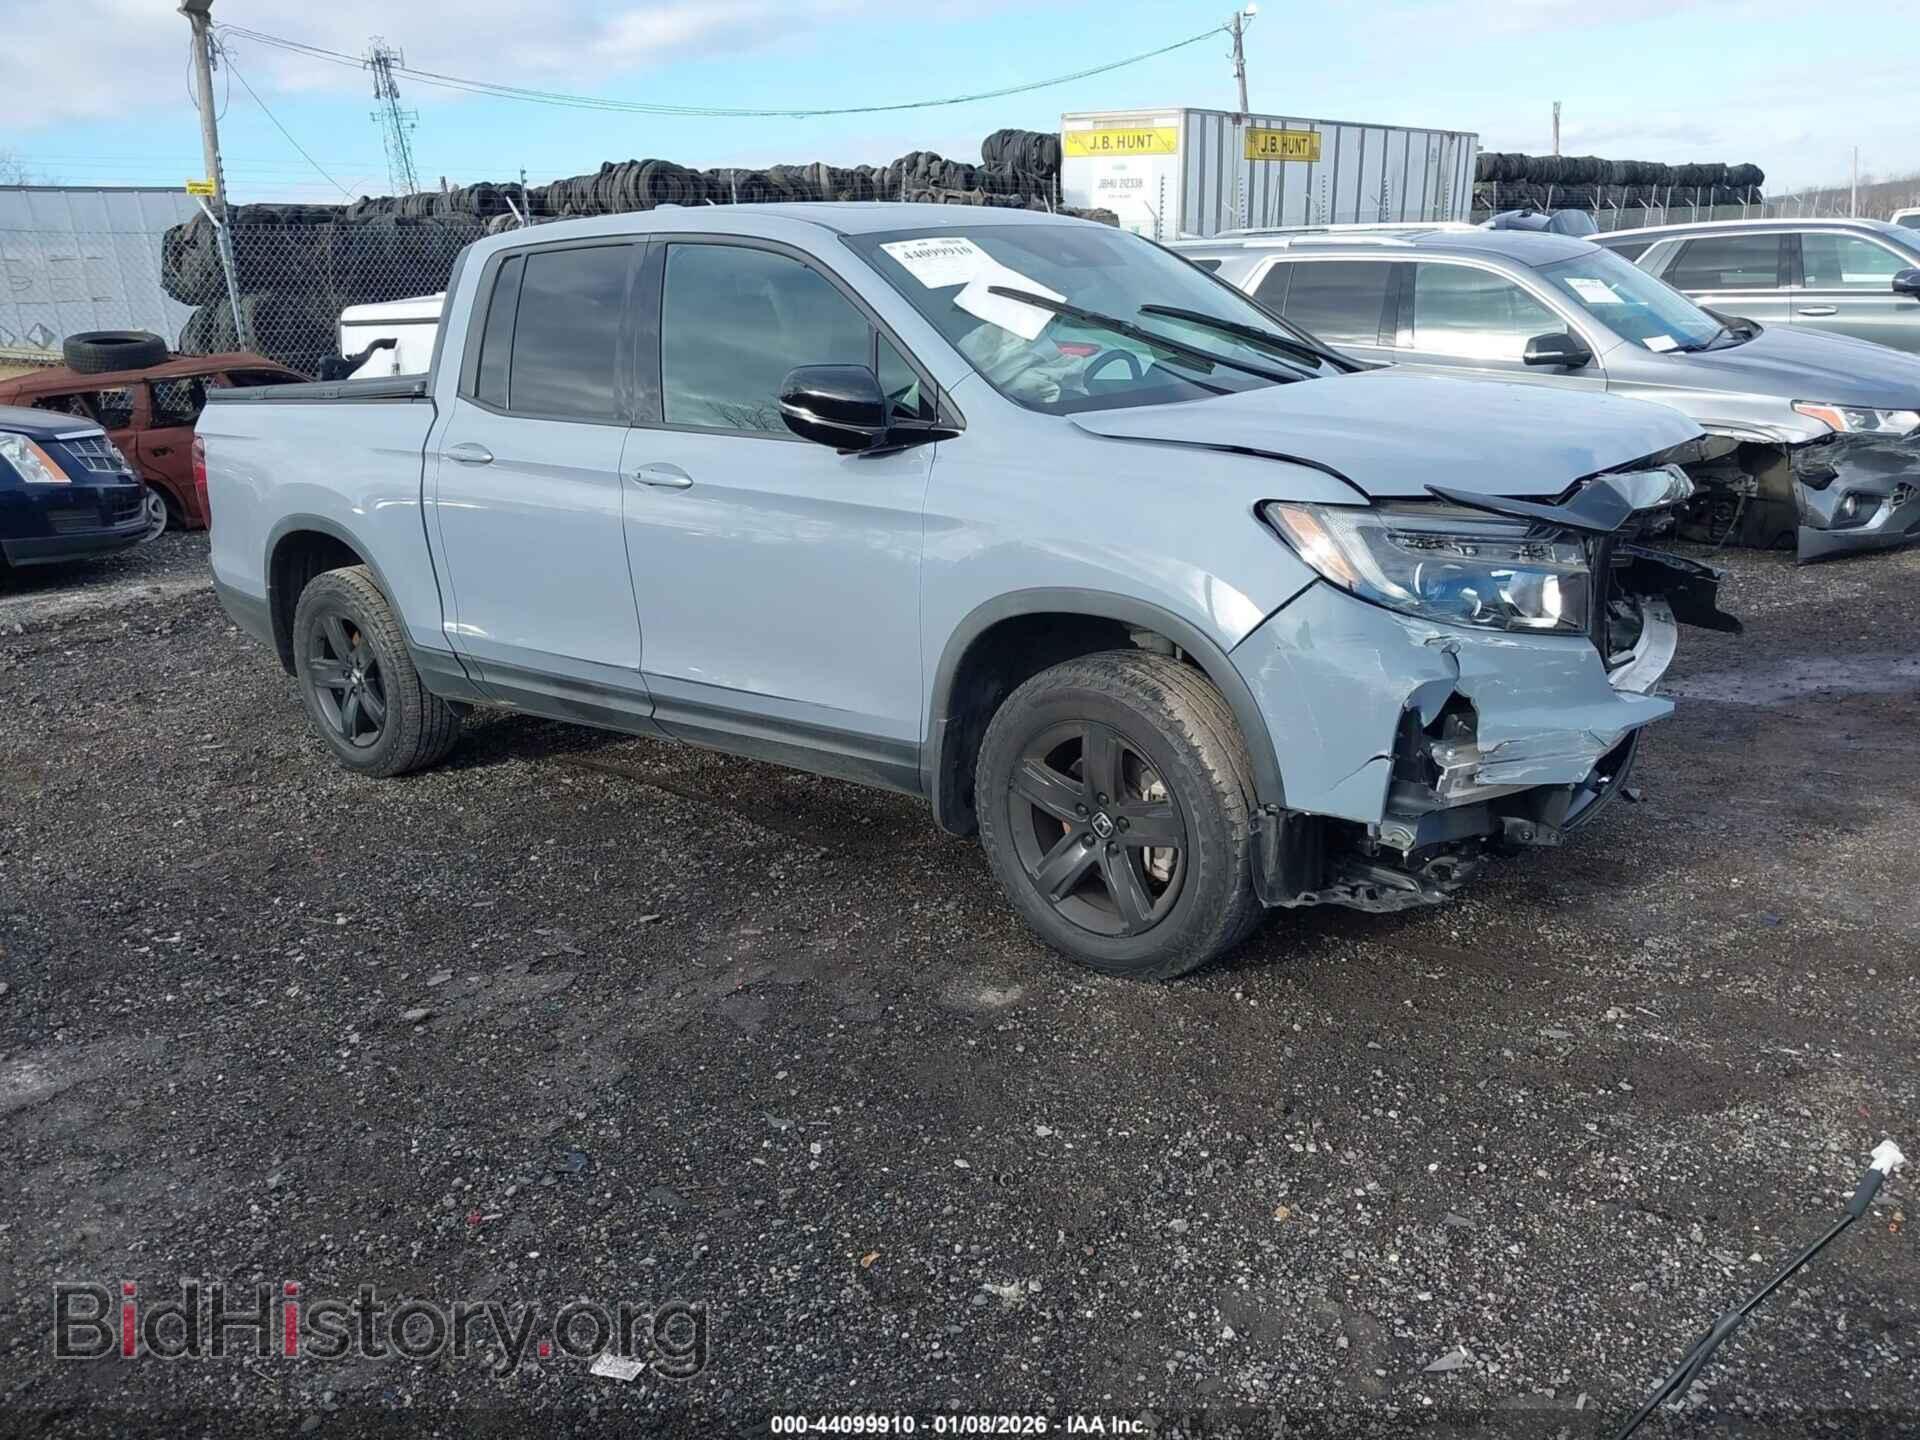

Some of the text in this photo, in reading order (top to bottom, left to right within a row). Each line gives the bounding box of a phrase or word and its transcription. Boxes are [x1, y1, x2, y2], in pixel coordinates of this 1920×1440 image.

[1089, 133, 1153, 150] J.B. HUNT
[1261, 135, 1307, 154] J.B. HUNT
